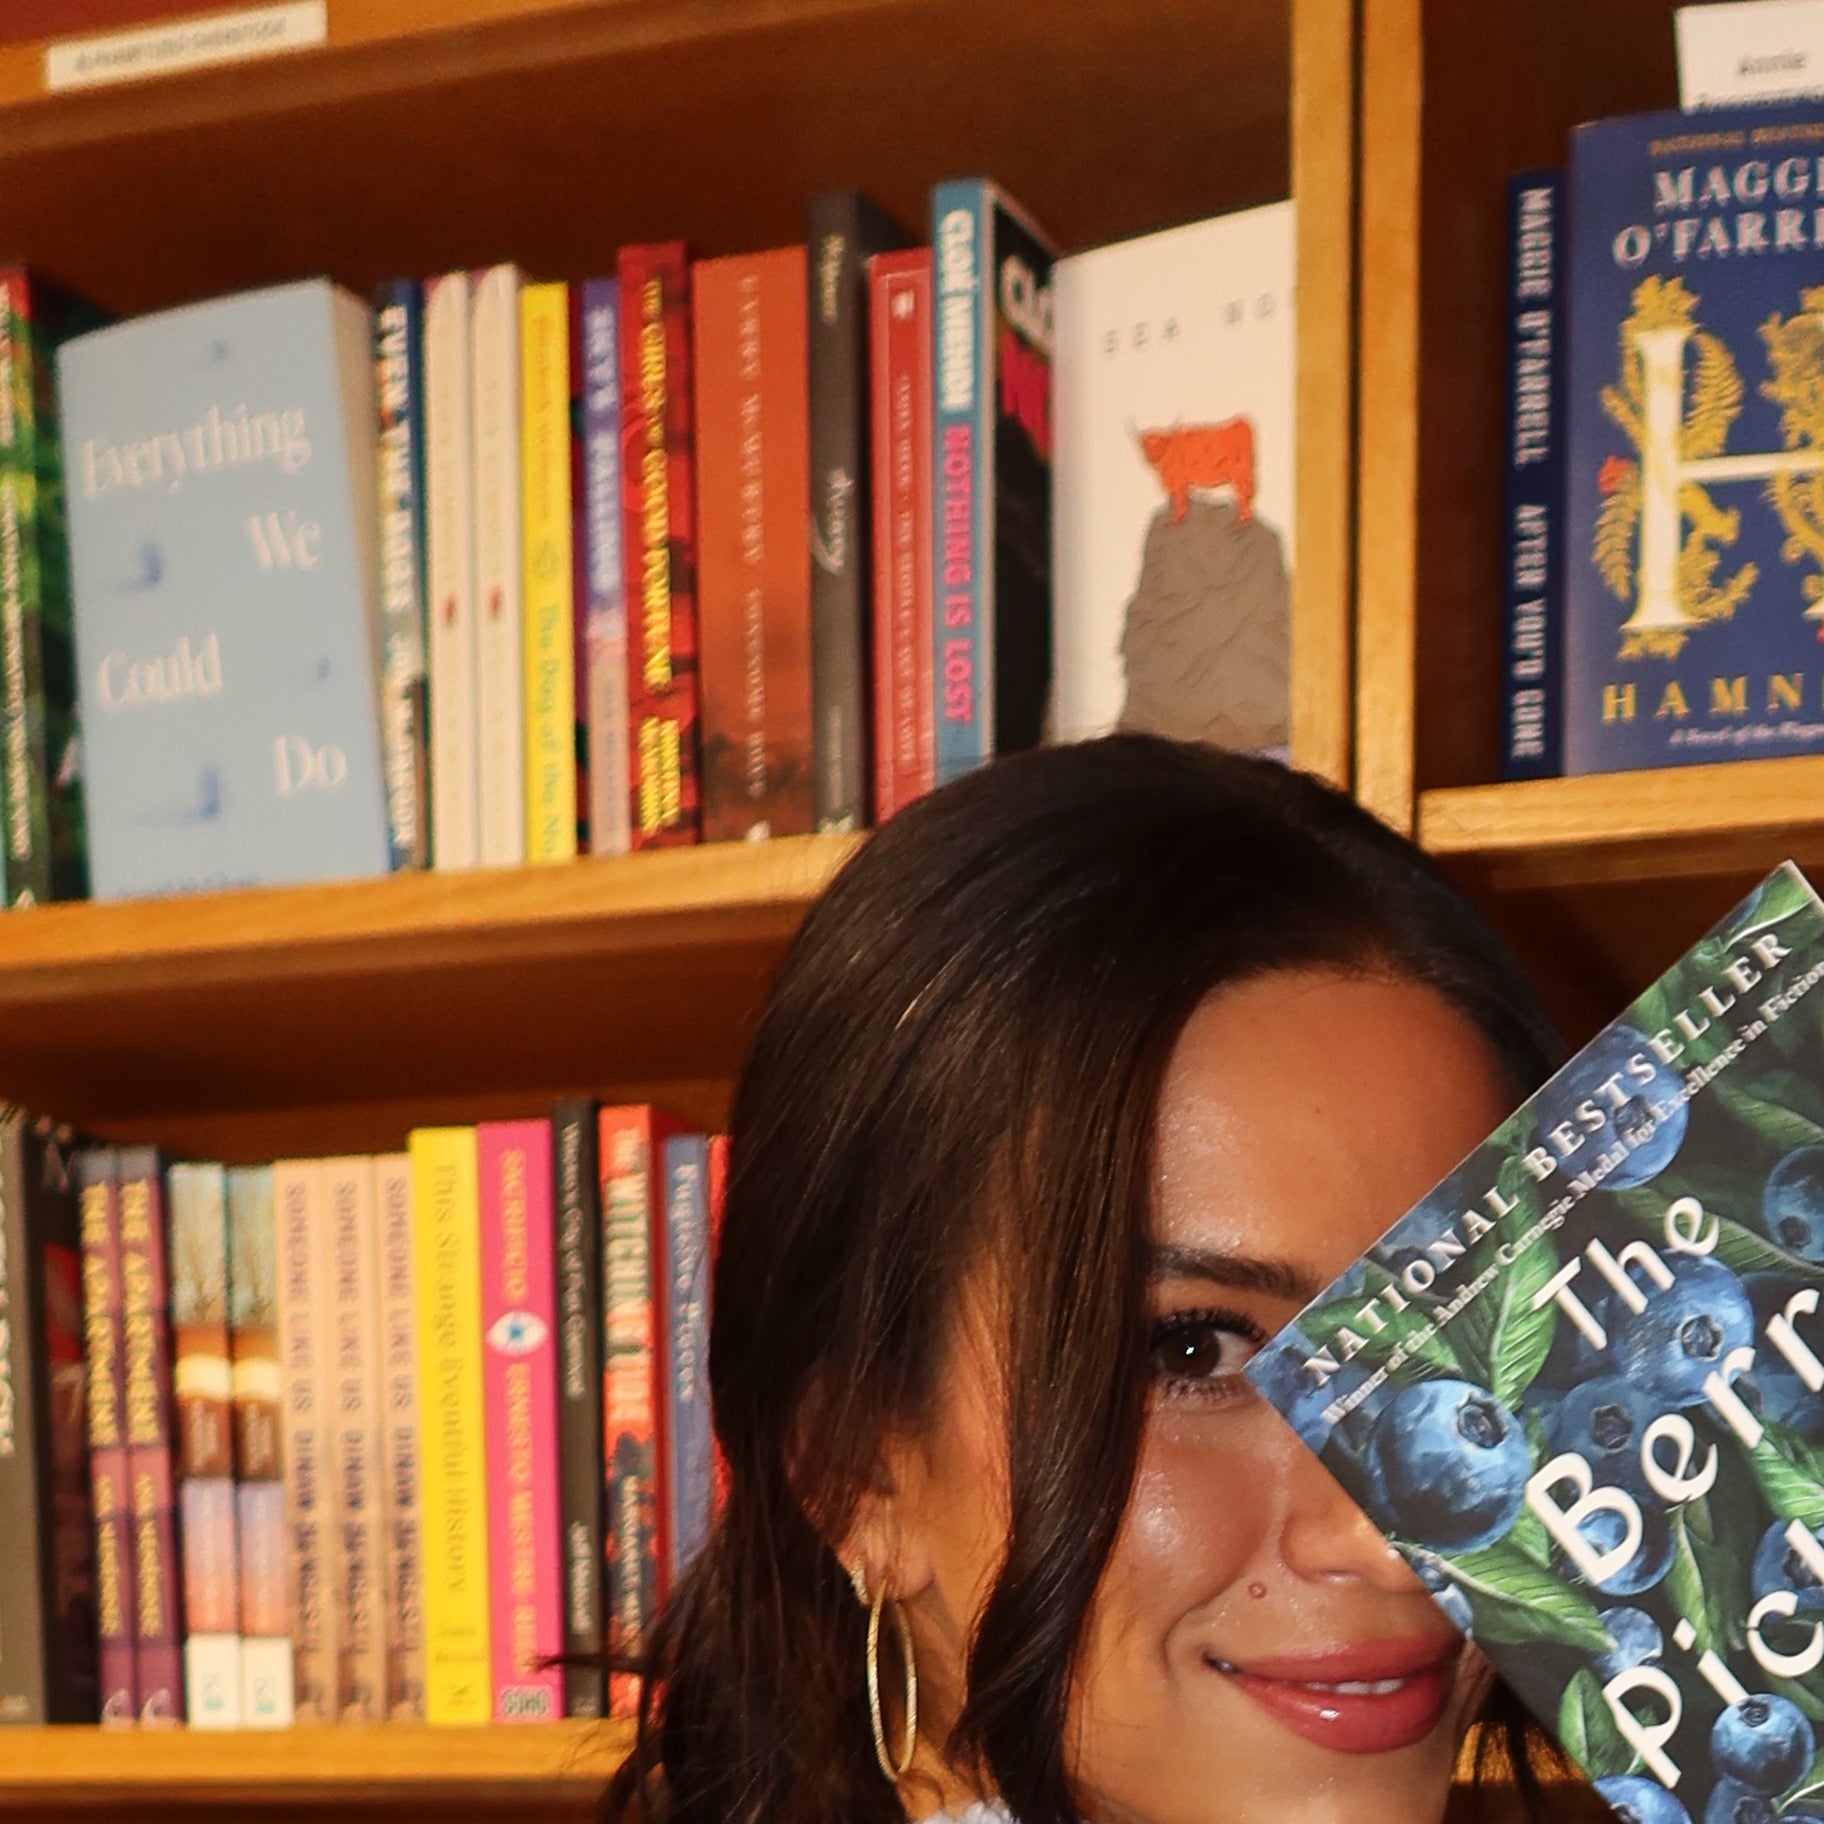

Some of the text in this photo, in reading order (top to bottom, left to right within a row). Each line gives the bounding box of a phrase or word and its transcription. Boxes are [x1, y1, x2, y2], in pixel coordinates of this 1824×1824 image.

[1512, 186, 1553, 467] MAGGIE O'FARRELL
[82, 404, 313, 497] Everything
[250, 512, 322, 571] We
[942, 424, 973, 722] NOTHING IS LOST
[1512, 504, 1546, 586] AFTER
[96, 633, 224, 710] Could
[273, 735, 347, 796] Do
[1511, 688, 1545, 758] GONE
[1303, 931, 1793, 1389] NATIONAL BESTSELLER
[1321, 1366, 1390, 1426] Winner
[1389, 1342, 1405, 1371] of
[1404, 1324, 1437, 1354] the
[1432, 1265, 1501, 1330] Andrew
[1495, 1195, 1575, 1267] Carnegie
[1565, 1143, 1628, 1199] Medal
[1623, 1115, 1657, 1148] for
[1650, 1037, 1748, 1119] Excellence
[1739, 1016, 1767, 1044] in
[1531, 1191, 1723, 1356] The
